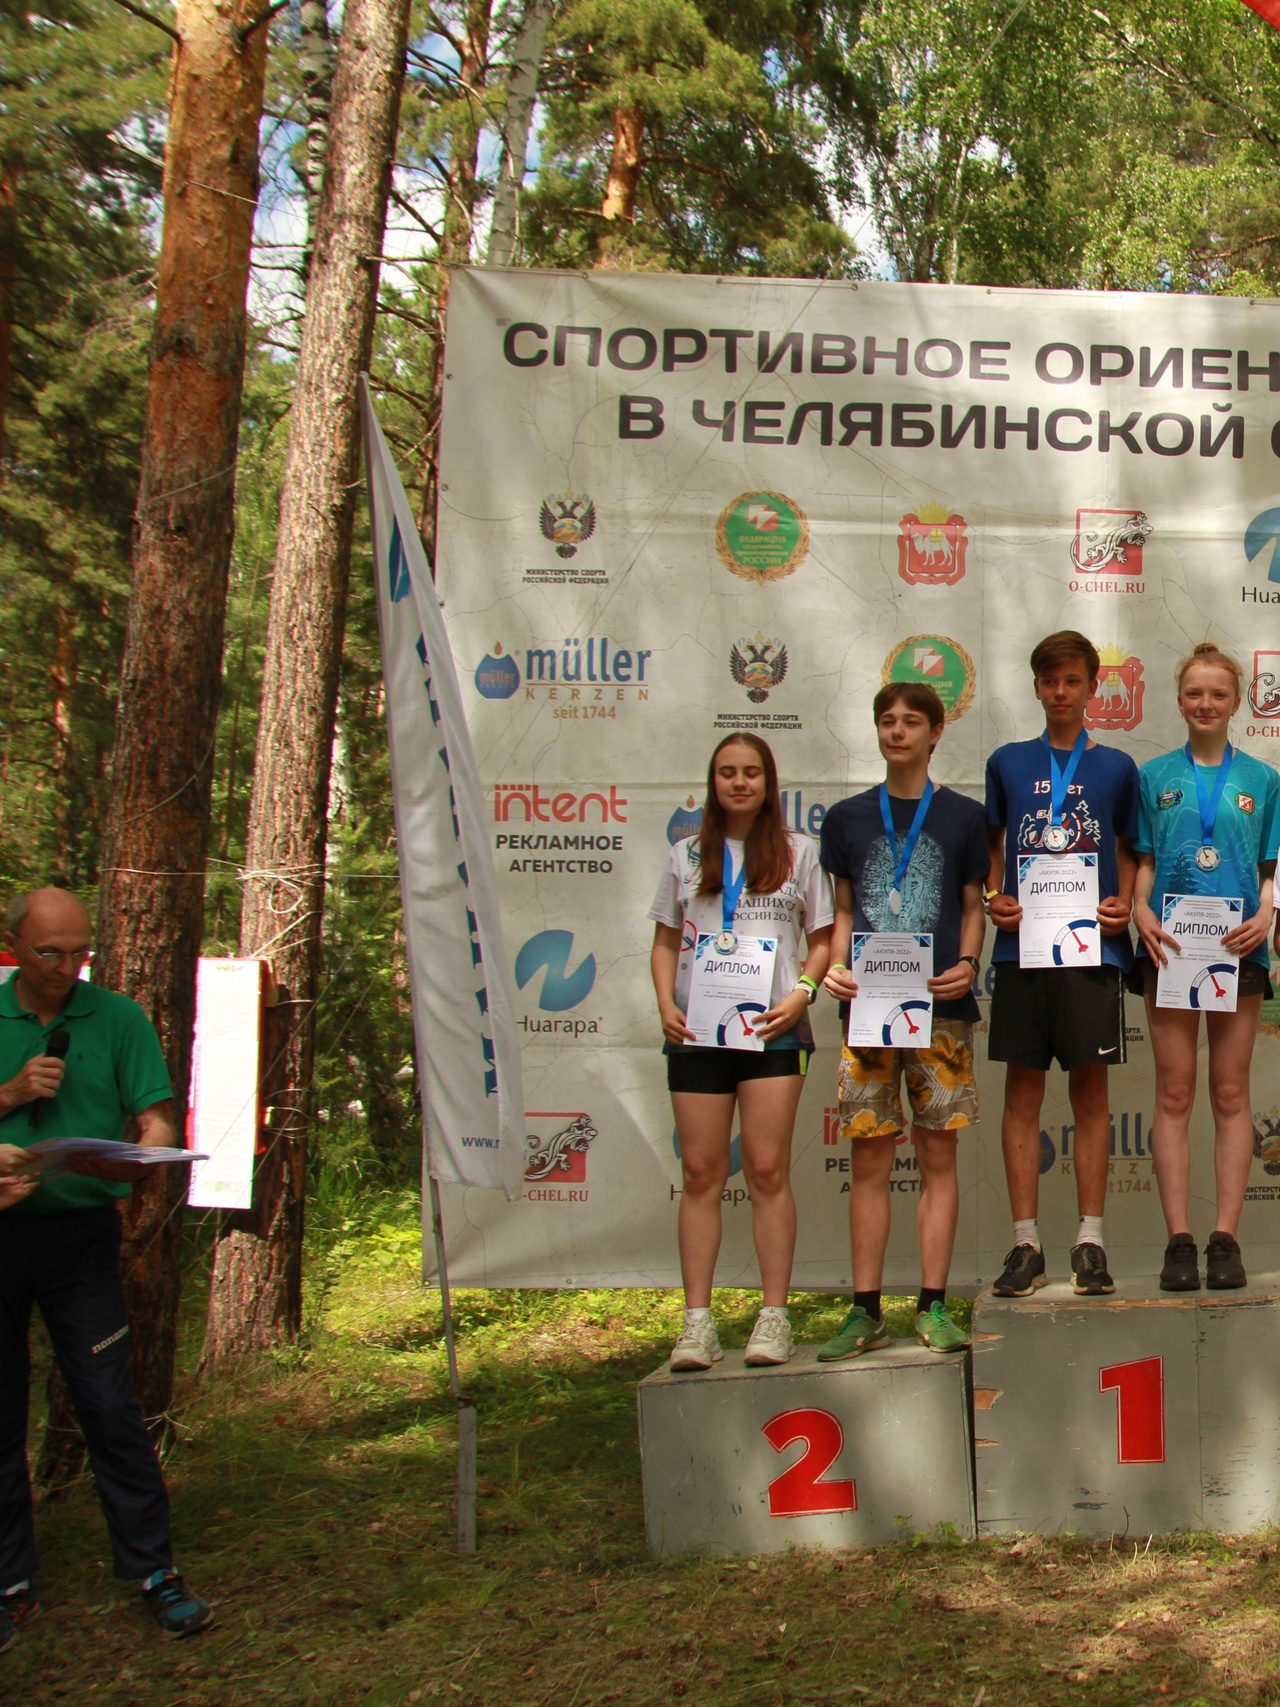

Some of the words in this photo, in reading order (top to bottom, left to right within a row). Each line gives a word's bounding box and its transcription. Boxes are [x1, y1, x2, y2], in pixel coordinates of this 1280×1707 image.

[503, 322, 1011, 381] СПОРТИВНОЕ
[618, 394, 665, 440] В
[692, 399, 1244, 459] ЧЕЛЯБИНСКОЙ
[1069, 581, 1145, 593] O-CHEL.RU
[526, 637, 652, 682] müller
[526, 688, 648, 700] KERZEN
[553, 706, 579, 719] seit
[582, 706, 616, 719] 1744
[714, 721, 758, 729] РОССИЙСКОЙ
[760, 722, 802, 730] ФЕДЕРАЦИИ
[1033, 780, 1051, 794] 15
[494, 784, 628, 823] intent
[496, 834, 623, 850] РЕКЛАМНОЕ
[509, 859, 613, 873] АГЕНТСТВО
[1030, 881, 1086, 895] ДИПЛОМ
[1173, 922, 1229, 935] ДИПЛОМ
[704, 960, 760, 975] ДИПЛОМ
[864, 960, 921, 973] ДИПЛОМ
[1117, 1180, 1151, 1193] 1744
[1099, 1355, 1165, 1464] 1
[760, 1408, 857, 1518] 2
